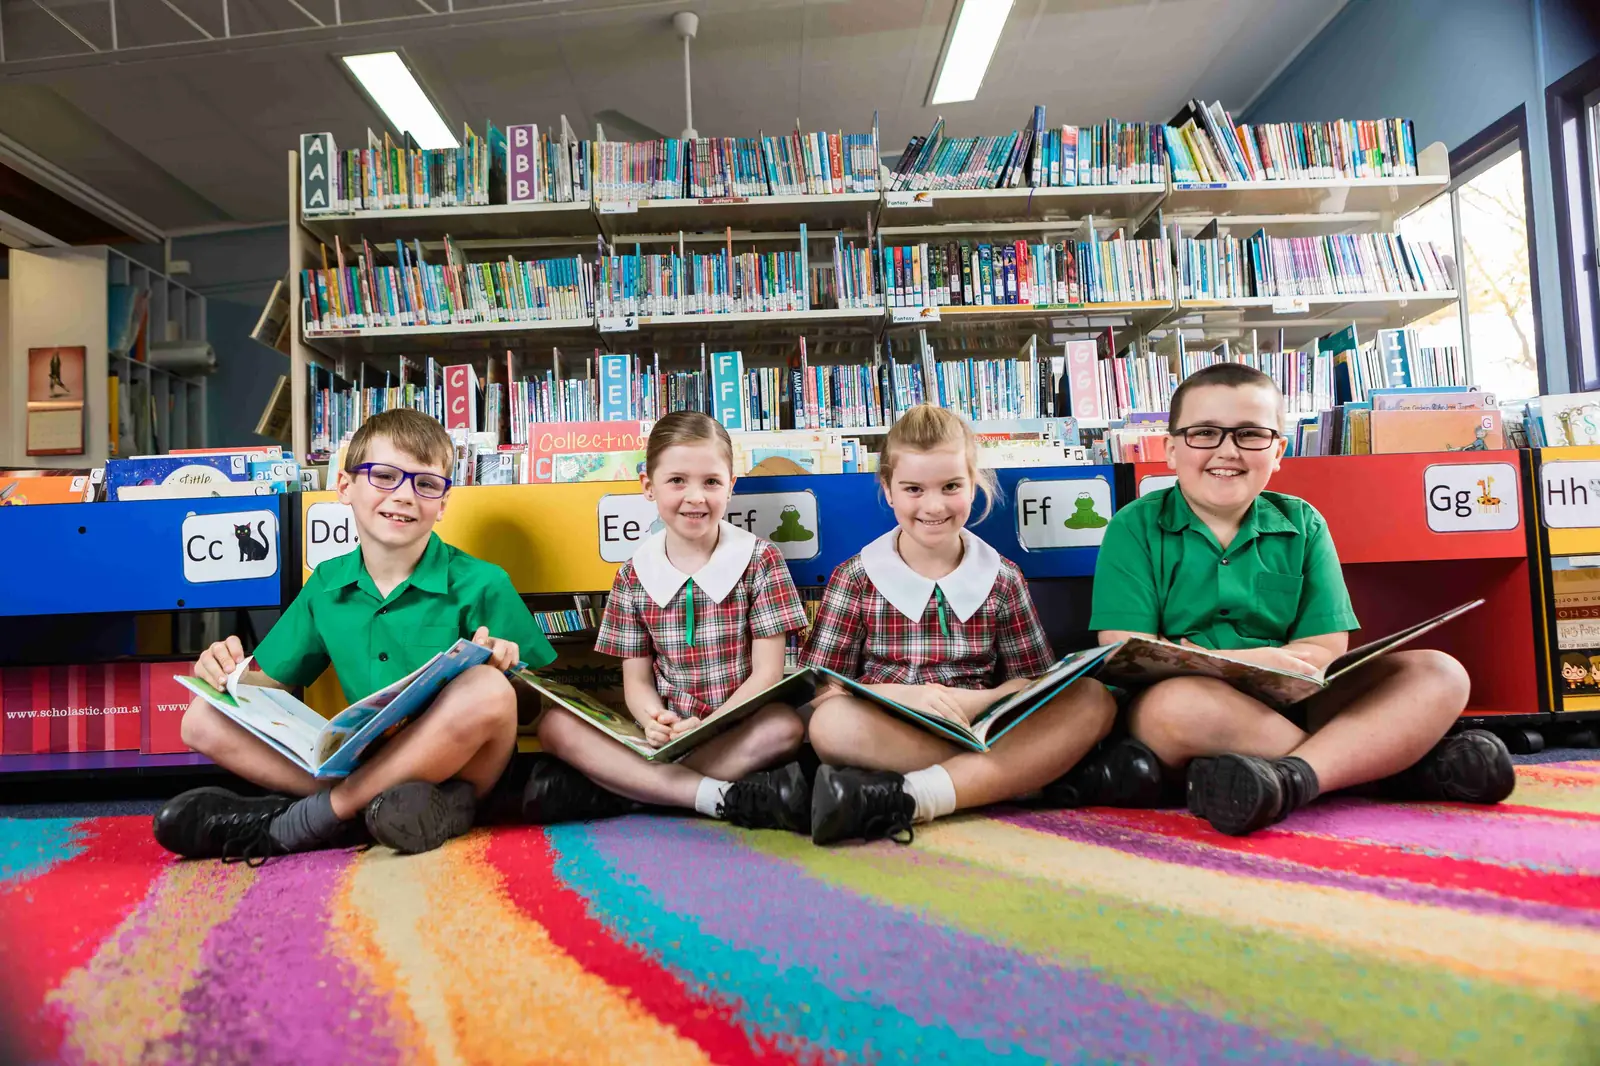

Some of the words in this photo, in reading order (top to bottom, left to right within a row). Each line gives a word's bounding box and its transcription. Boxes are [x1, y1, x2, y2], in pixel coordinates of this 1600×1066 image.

[793, 371, 802, 393] AMARI
[1484, 395, 1494, 405] G
[1482, 417, 1492, 428] G
[539, 431, 646, 452] Collecting
[831, 435, 838, 444] F
[842, 447, 849, 457] F
[1064, 448, 1070, 458] F
[233, 458, 243, 469] C
[502, 456, 511, 465] D
[92, 470, 101, 480] C
[274, 465, 283, 476] C
[286, 465, 294, 476] C
[73, 478, 83, 487] C
[179, 473, 212, 484] Little
[303, 473, 312, 482] D
[1547, 476, 1588, 505] Hh
[1429, 484, 1472, 518] Gg
[1022, 496, 1052, 526] Ff
[311, 517, 349, 544] Dd
[603, 514, 640, 542] Ee
[186, 534, 223, 562] Cc
[157, 703, 189, 712] www
